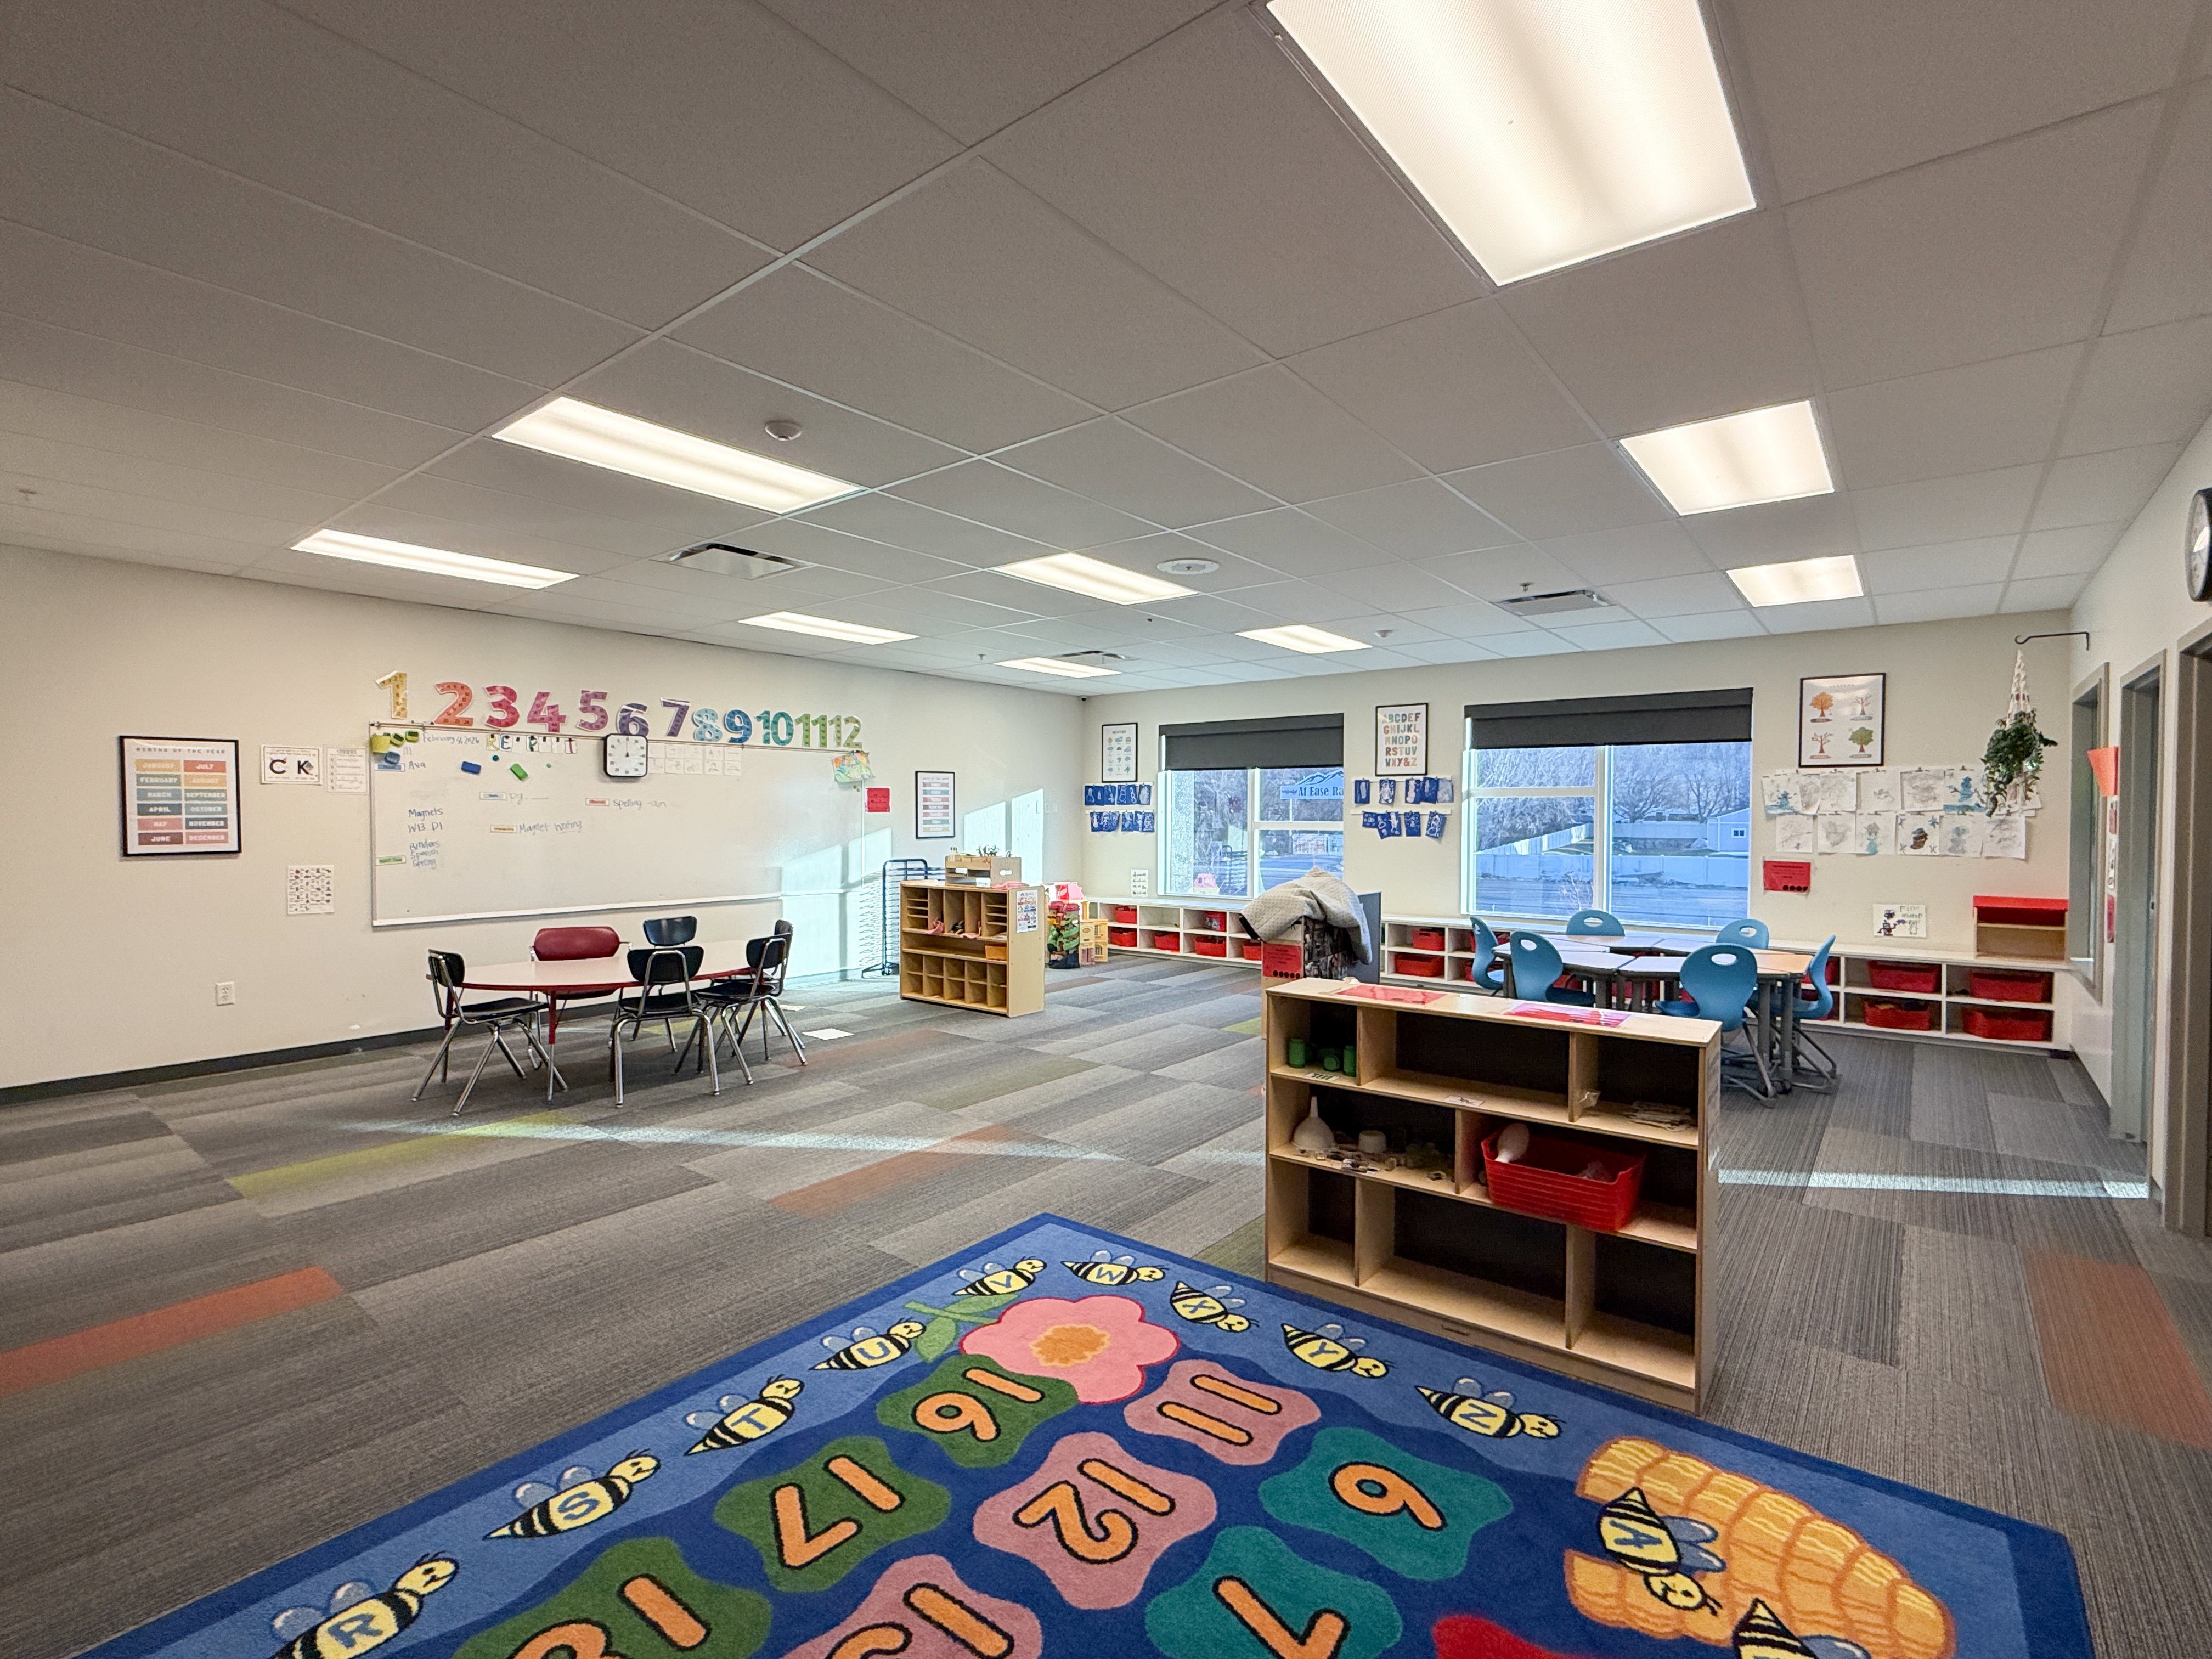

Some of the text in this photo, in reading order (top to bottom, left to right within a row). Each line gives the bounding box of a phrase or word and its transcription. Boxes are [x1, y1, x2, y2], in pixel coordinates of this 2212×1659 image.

[434, 681, 473, 727] 2
[484, 685, 520, 728] 3
[527, 691, 567, 733] 4
[577, 690, 608, 732] 5
[618, 702, 649, 736] 6
[661, 697, 690, 737] 7
[693, 708, 723, 742] 8
[725, 709, 752, 743] 9
[755, 710, 794, 746] 10
[794, 713, 827, 748] 11
[828, 715, 862, 749] 12
[269, 759, 311, 775] C K
[1299, 787, 1307, 797] At
[1310, 786, 1329, 796] Ease
[991, 1274, 1013, 1288] V
[1095, 1266, 1125, 1282] W
[1182, 1300, 1216, 1313] X
[857, 1341, 891, 1360] U
[1308, 1341, 1339, 1358] Y
[730, 1407, 768, 1431] T
[1459, 1403, 1497, 1429] Z
[557, 1491, 599, 1520] S
[1609, 1519, 1662, 1549] A
[326, 1613, 383, 1649] R
